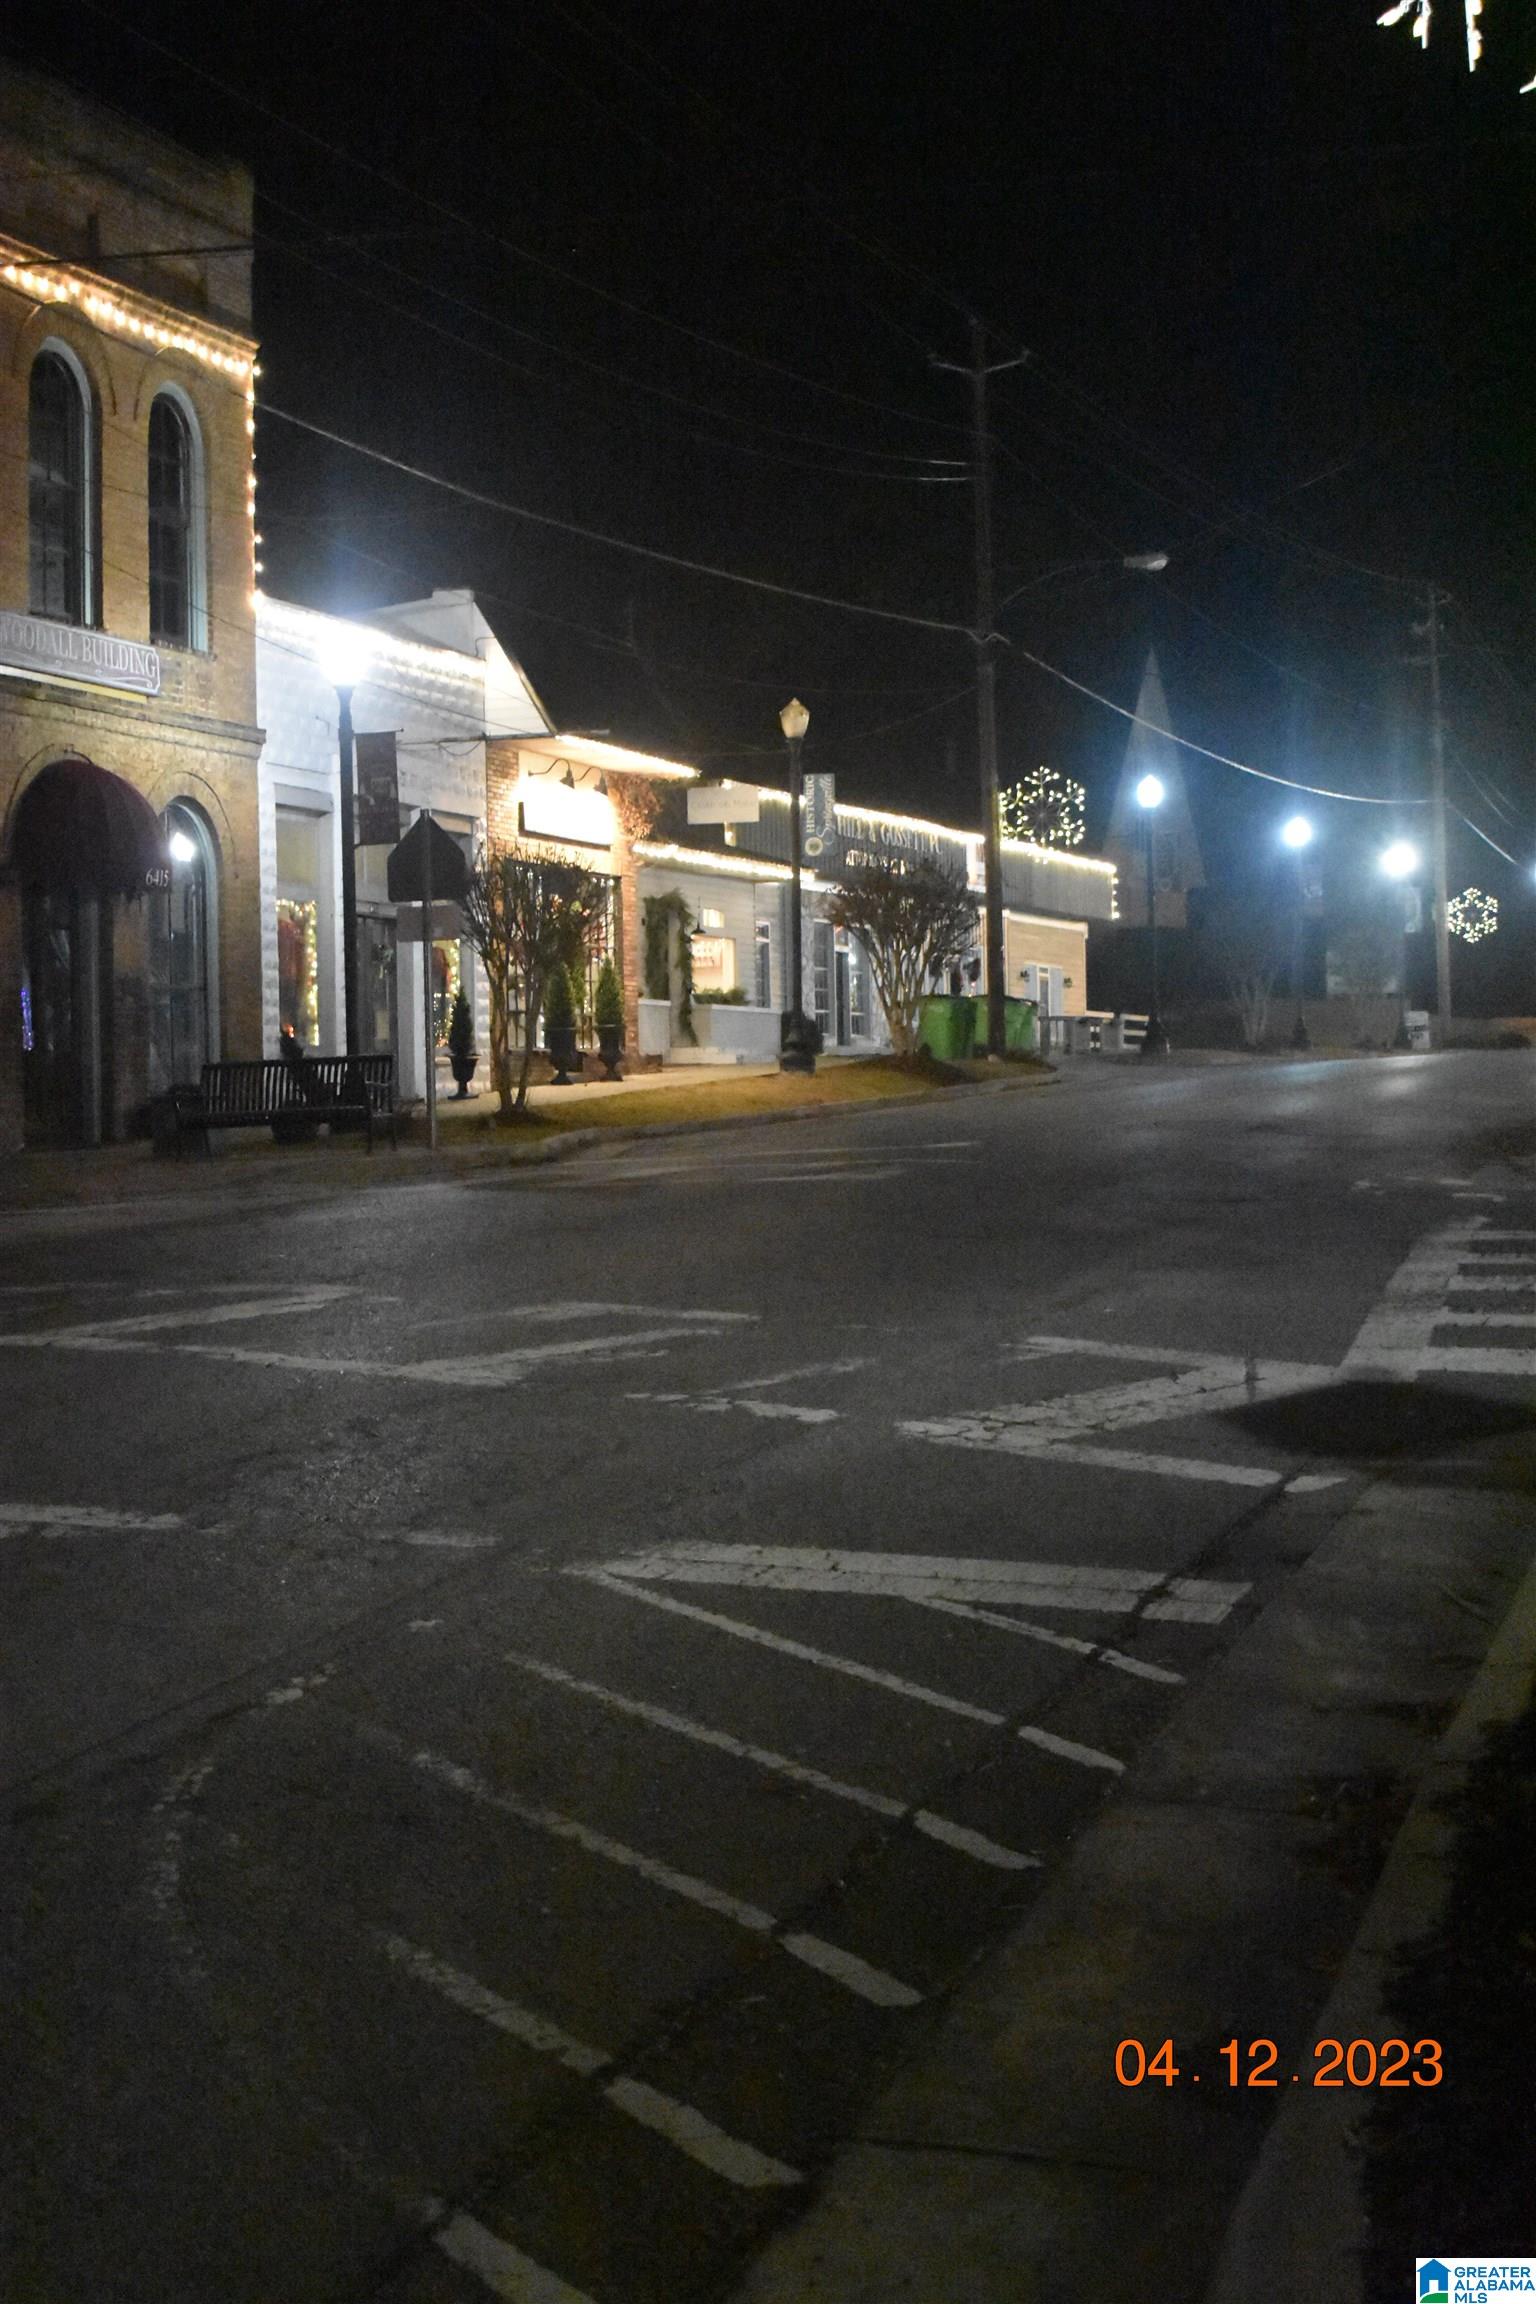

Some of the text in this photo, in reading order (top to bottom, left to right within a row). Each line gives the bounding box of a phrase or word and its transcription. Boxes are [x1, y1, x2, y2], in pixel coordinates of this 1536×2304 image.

[82, 636, 156, 679] BUILDING
[805, 775, 815, 833] HISTORIC
[145, 868, 169, 888] 6415
